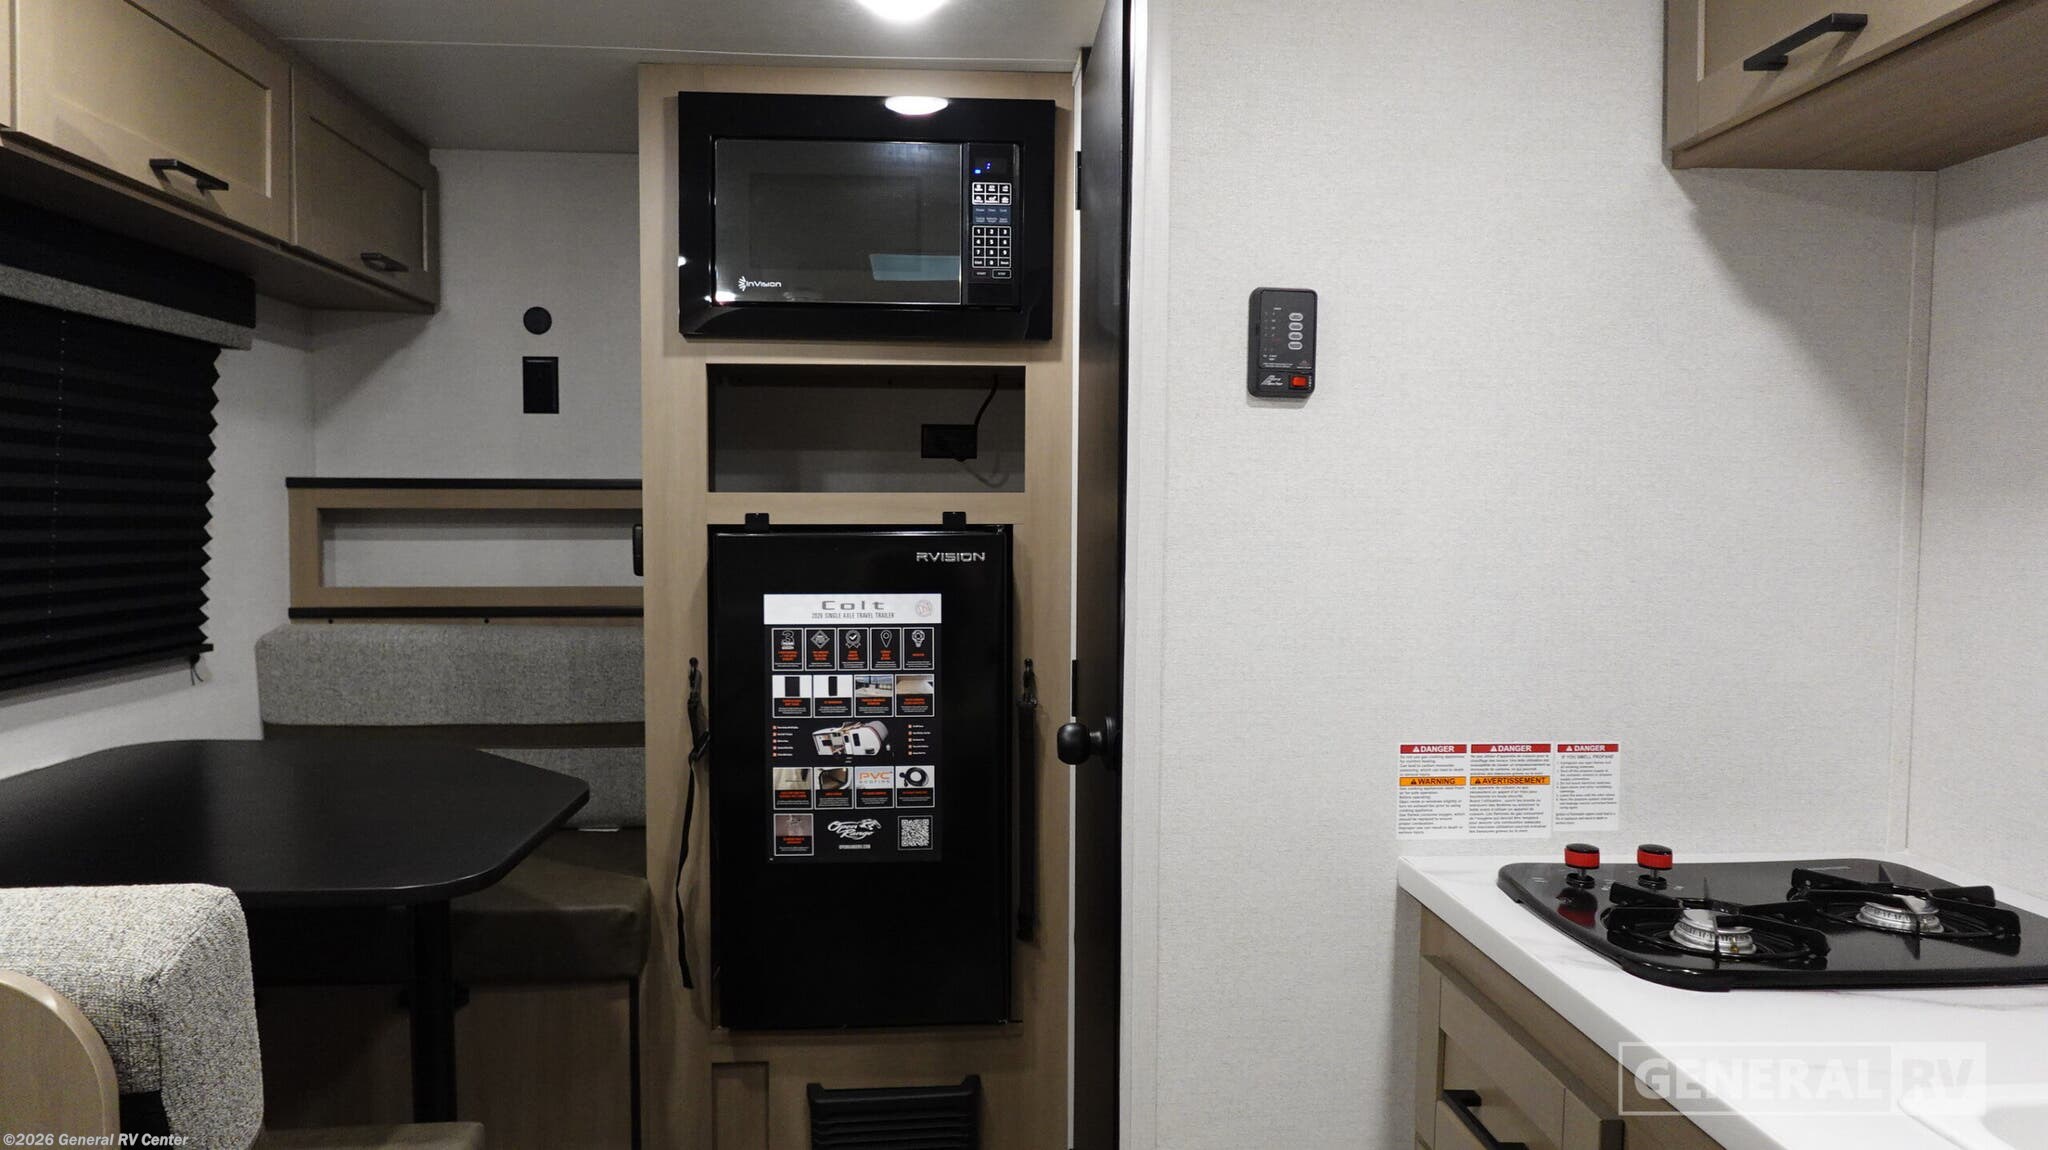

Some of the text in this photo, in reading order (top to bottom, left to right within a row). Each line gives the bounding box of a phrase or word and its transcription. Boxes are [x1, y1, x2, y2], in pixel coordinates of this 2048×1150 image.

[915, 552, 986, 563] RVISION
[822, 600, 885, 611] Colt
[1420, 745, 1455, 753] DANGER
[1497, 744, 1532, 752] DANGER
[1573, 744, 1606, 752] DANGER
[859, 771, 893, 780] PVC
[1481, 777, 1546, 785] AVERTISSEMENT
